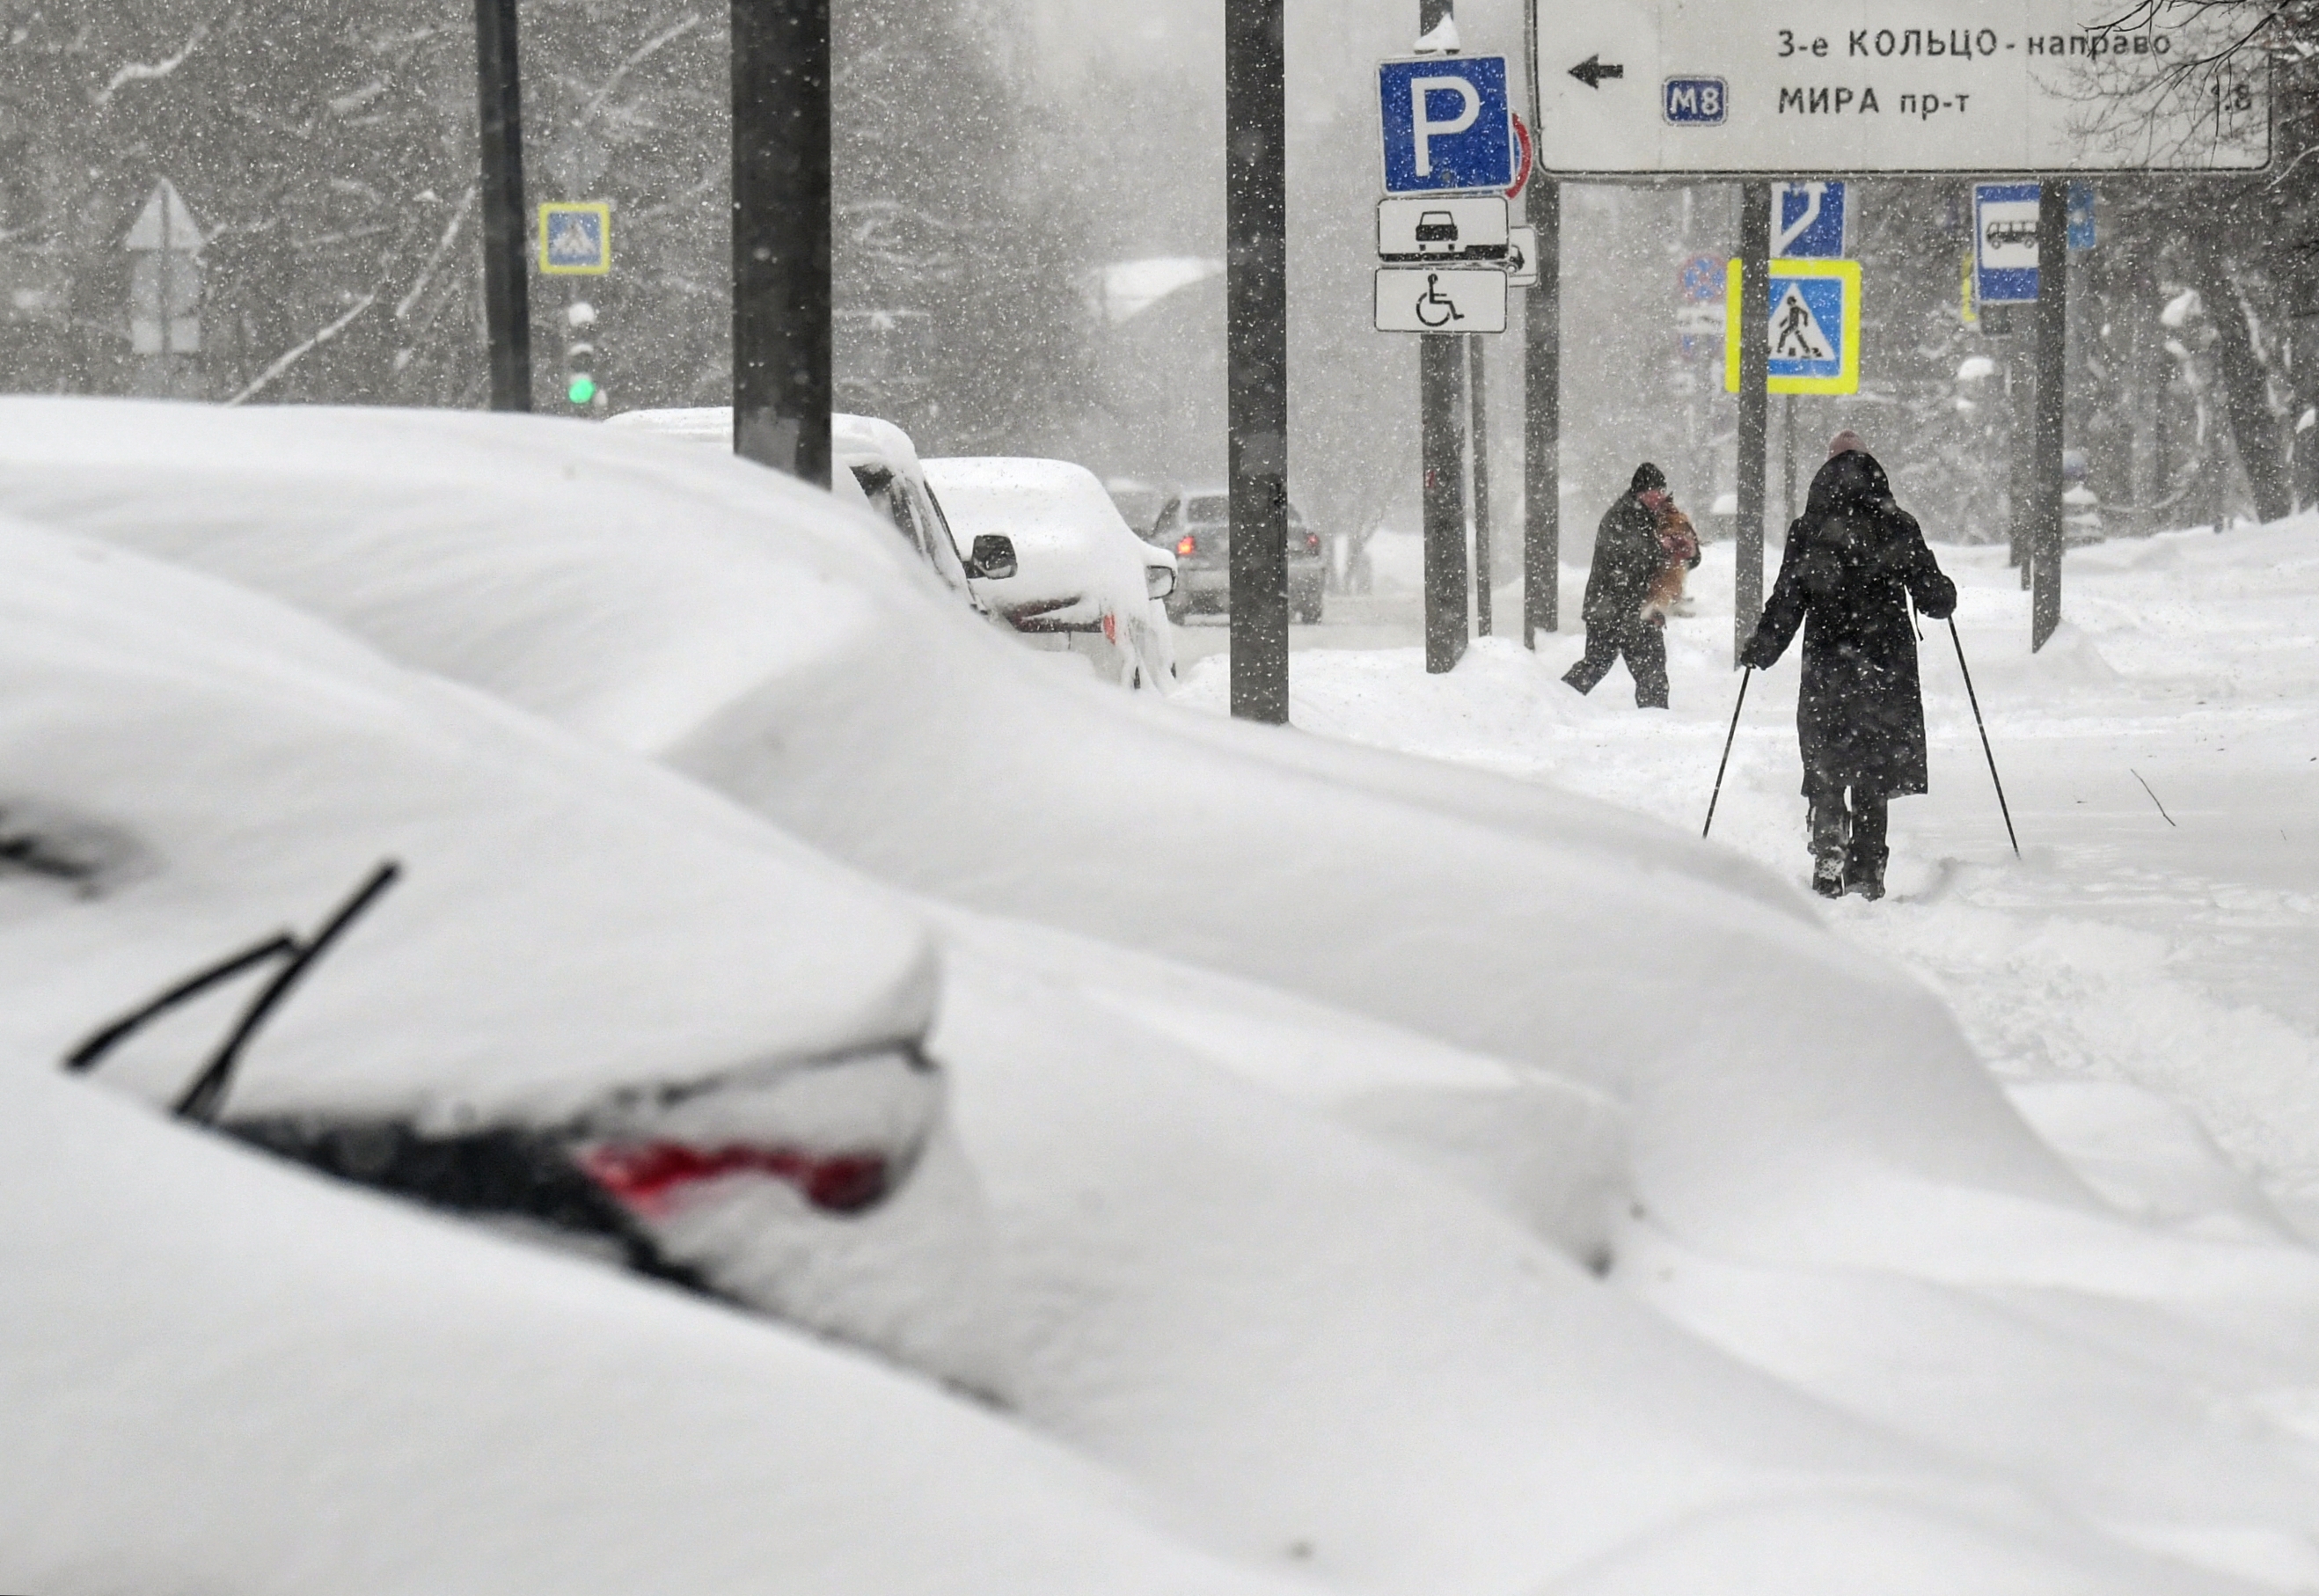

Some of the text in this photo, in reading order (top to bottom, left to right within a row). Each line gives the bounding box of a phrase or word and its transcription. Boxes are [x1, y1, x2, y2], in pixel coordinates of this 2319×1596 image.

[1778, 29, 1829, 57] 3-е
[1671, 86, 1720, 115] М8
[1778, 86, 1970, 121] МИРА пр-т
[1411, 76, 1481, 177] P
